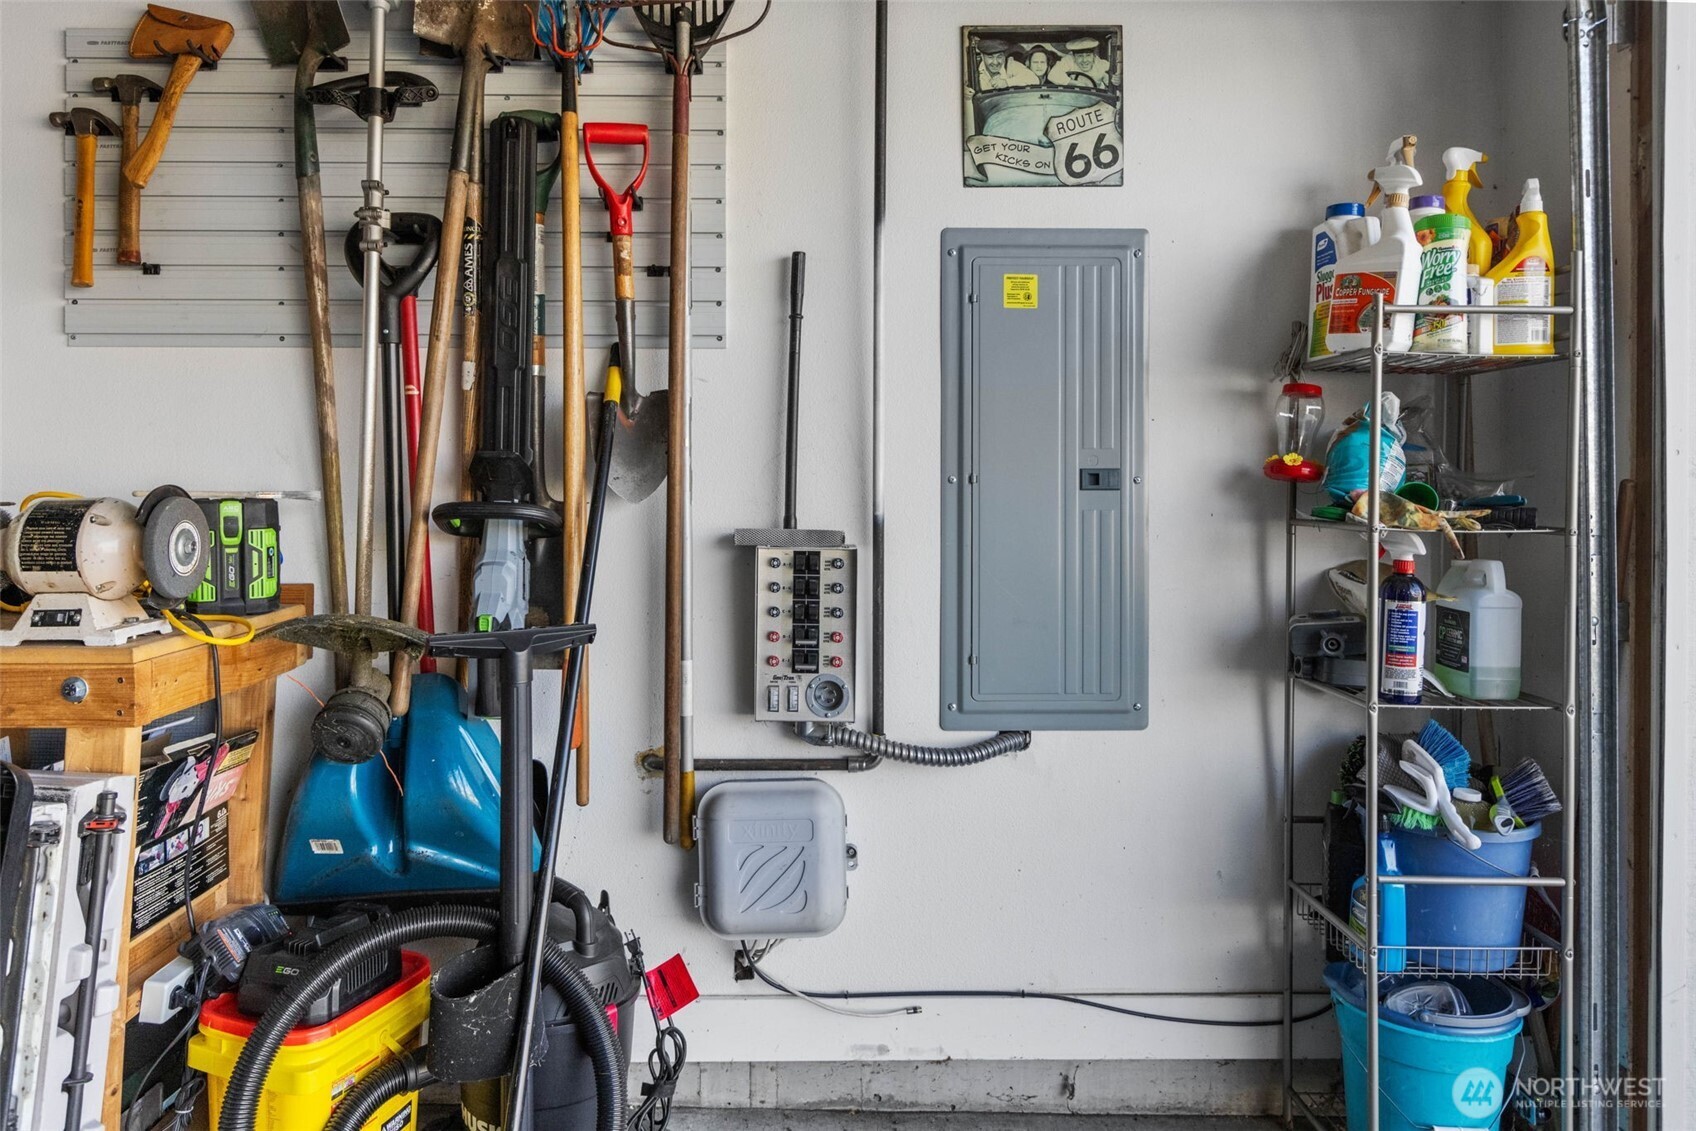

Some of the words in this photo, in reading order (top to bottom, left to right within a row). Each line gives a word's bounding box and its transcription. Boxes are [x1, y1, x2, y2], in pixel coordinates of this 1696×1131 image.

[1055, 109, 1104, 135] ROUTE
[973, 143, 997, 155] GET
[1001, 142, 1031, 154] YOUR
[1064, 132, 1120, 179] 66
[995, 152, 1031, 168] KICKS
[1034, 160, 1051, 169] ON
[464, 242, 474, 278] AMES
[1420, 246, 1462, 270] Worry
[1419, 262, 1458, 289] Free
[1335, 287, 1358, 297] COPPER
[1357, 287, 1391, 297] FUNGICIDE
[228, 565, 236, 588] EGO
[275, 965, 300, 976] EGO
